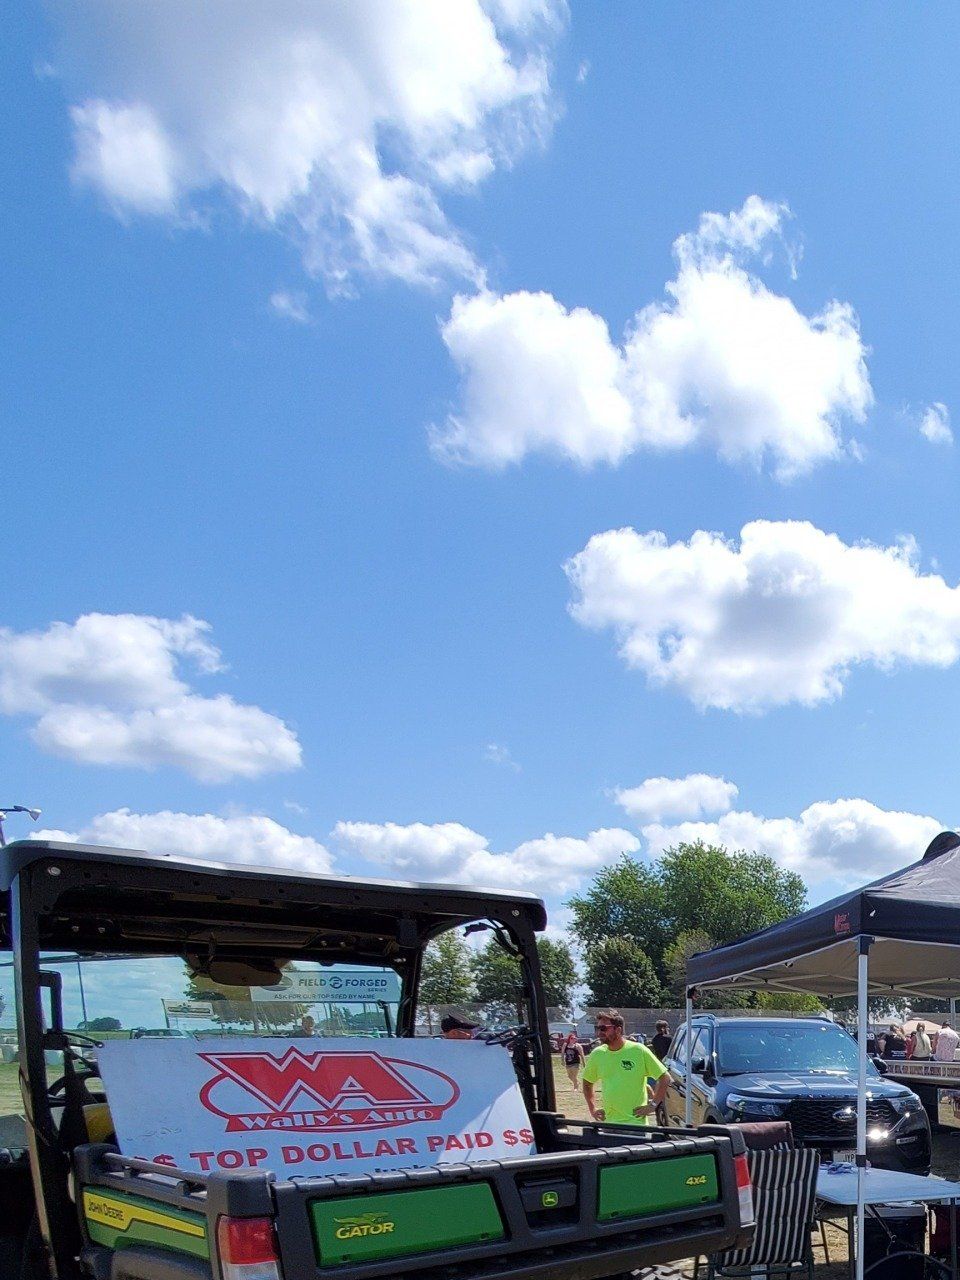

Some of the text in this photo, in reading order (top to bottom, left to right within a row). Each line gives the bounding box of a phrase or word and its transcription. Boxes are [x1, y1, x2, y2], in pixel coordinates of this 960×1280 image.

[298, 978, 388, 987] FIELD FORGED
[238, 1108, 434, 1130] Wally's Auto
[189, 1148, 268, 1171] TOP
[281, 1137, 419, 1165] DOLLAR
[426, 1131, 494, 1153] PAID
[502, 1128, 535, 1147] $$
[88, 1199, 125, 1221] JOHN DEERE
[336, 1222, 395, 1240] GATOR
